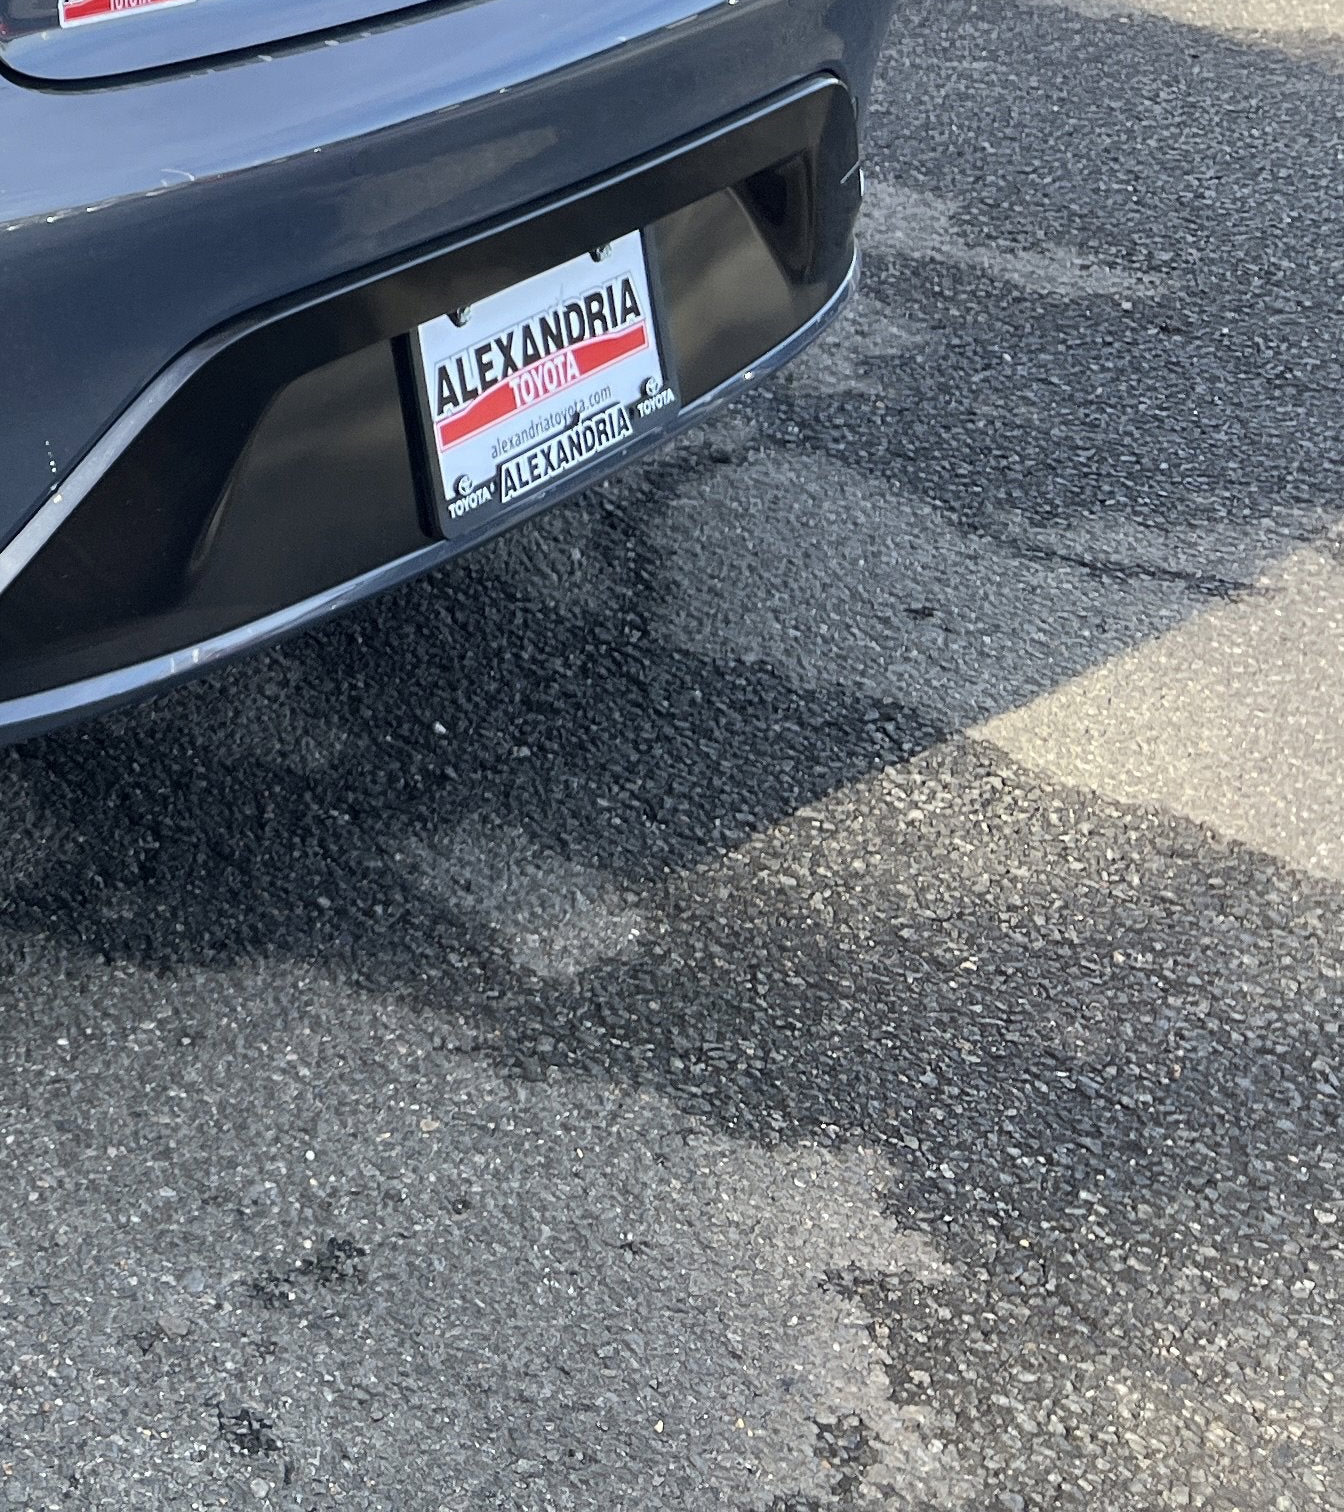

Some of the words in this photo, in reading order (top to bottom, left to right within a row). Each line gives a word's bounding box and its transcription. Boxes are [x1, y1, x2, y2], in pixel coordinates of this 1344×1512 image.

[436, 276, 641, 417] ALEXANDRIA
[509, 350, 580, 409] TOYOTA
[448, 485, 493, 520] TOYOTA
[503, 406, 631, 497] ALEXANDRIA
[637, 387, 675, 419] TOYOTA
[490, 384, 612, 460] alexandriatoyota.com
